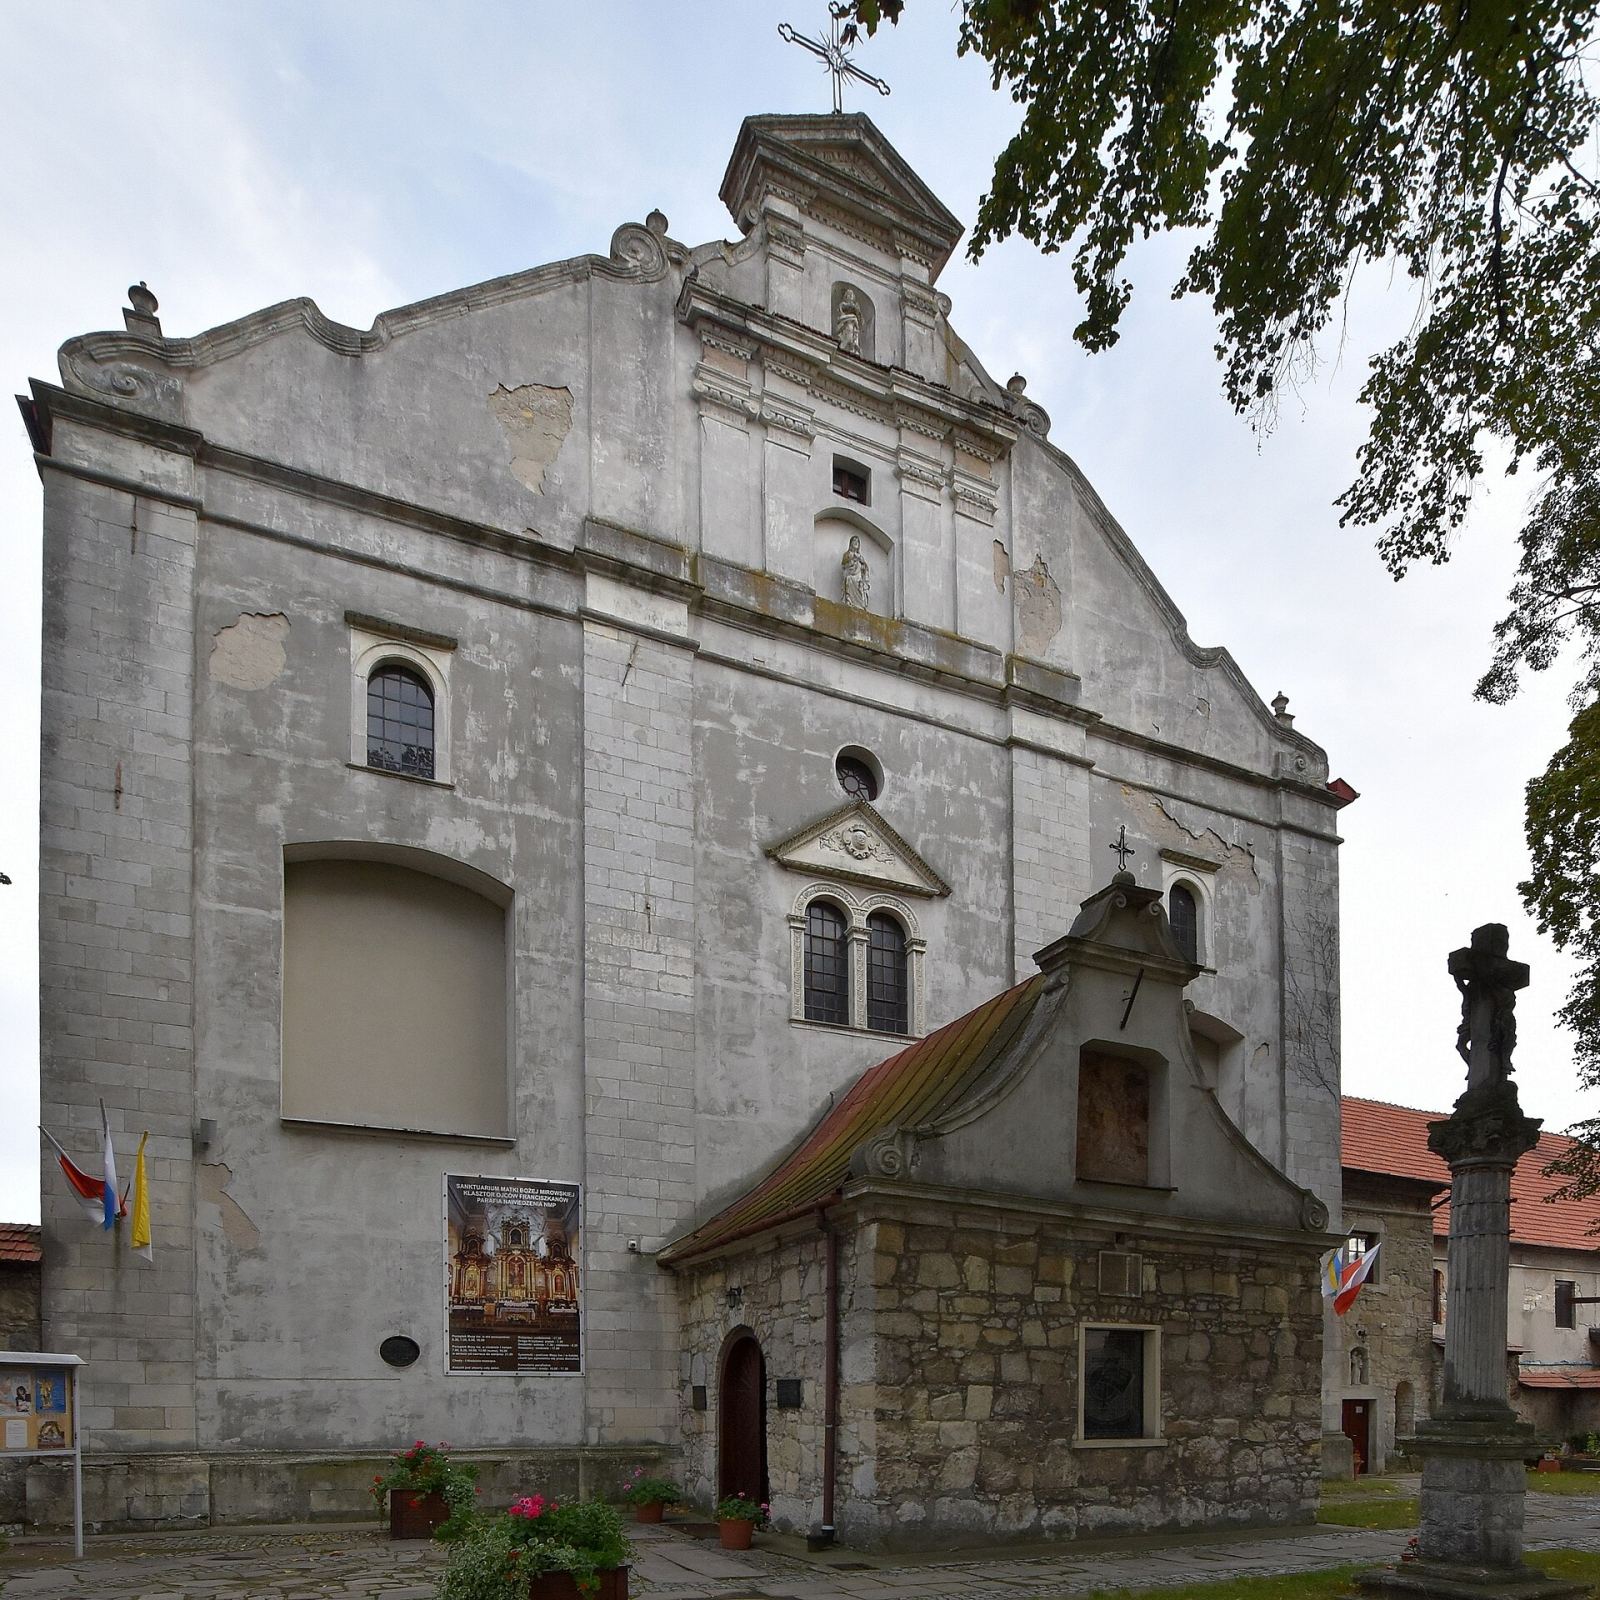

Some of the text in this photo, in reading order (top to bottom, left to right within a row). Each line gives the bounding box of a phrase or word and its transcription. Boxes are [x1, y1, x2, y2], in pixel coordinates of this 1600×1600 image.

[456, 1183, 499, 1191] SANKTUARIUM
[540, 1189, 575, 1198] MIROWSKIEJ
[463, 1190, 495, 1198] KLASZTOR
